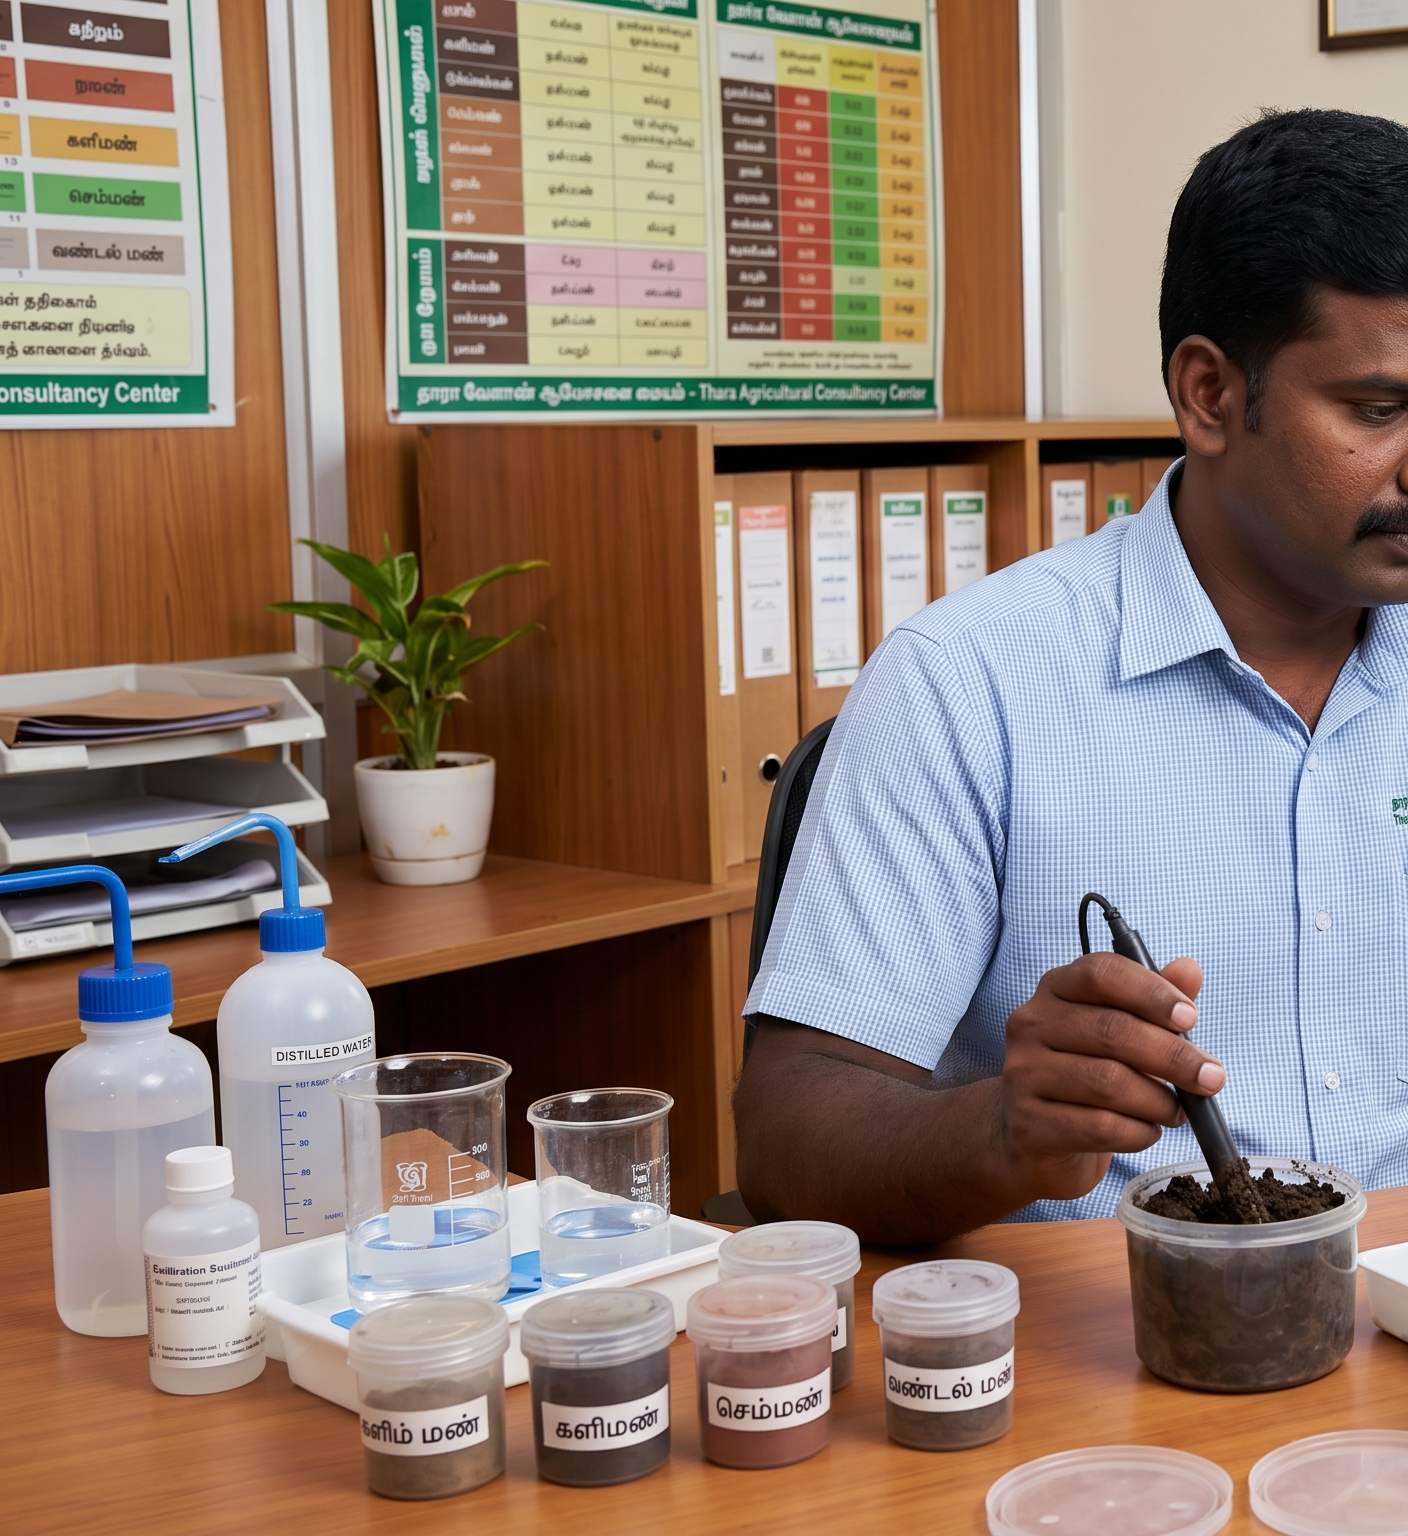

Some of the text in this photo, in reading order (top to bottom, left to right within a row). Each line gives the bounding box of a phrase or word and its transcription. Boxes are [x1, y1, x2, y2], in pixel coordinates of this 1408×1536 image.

[67, 132, 138, 152] களிமண்
[69, 188, 146, 207] செம்மண்
[52, 242, 165, 262] வண்டல் மண்
[114, 381, 181, 404] Center
[276, 1036, 373, 1062] DISTILLED WATER
[297, 1110, 307, 1118] 40
[888, 1376, 973, 1400] வண்டல்
[715, 1386, 824, 1421] செம்மண்
[421, 1413, 480, 1445] மண்
[555, 1405, 660, 1440] களிமண்
